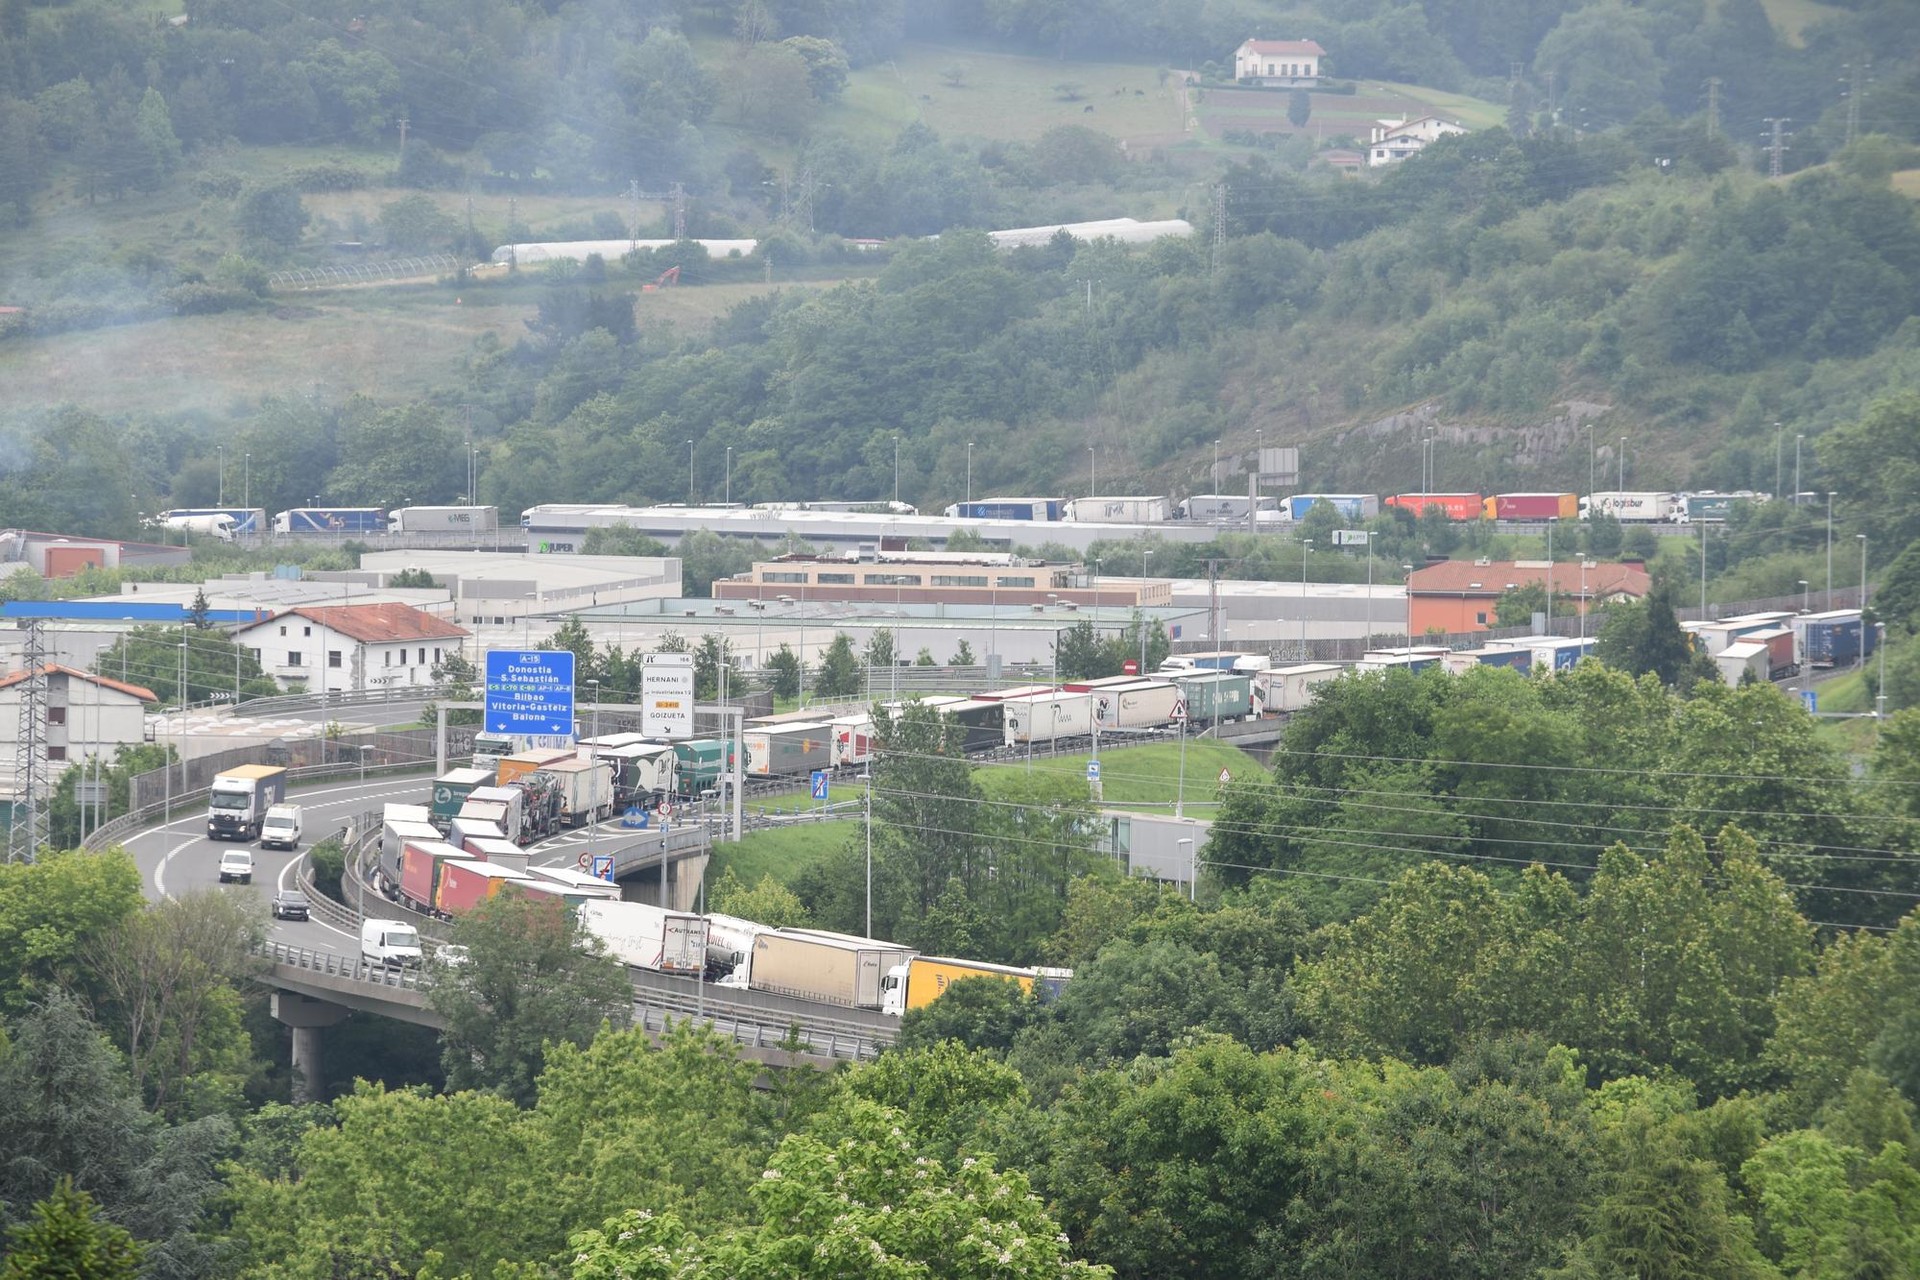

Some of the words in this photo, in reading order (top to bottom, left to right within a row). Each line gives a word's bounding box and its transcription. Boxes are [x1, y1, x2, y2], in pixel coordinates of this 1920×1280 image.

[1612, 498, 1643, 508] logisbur
[508, 665, 552, 674] Donostia
[501, 674, 509, 682] S.
[511, 674, 559, 683] Sebastián
[514, 693, 545, 701] Bilbao
[491, 702, 568, 712] Vitoria-Gasteiz
[512, 713, 546, 721] Baiona
